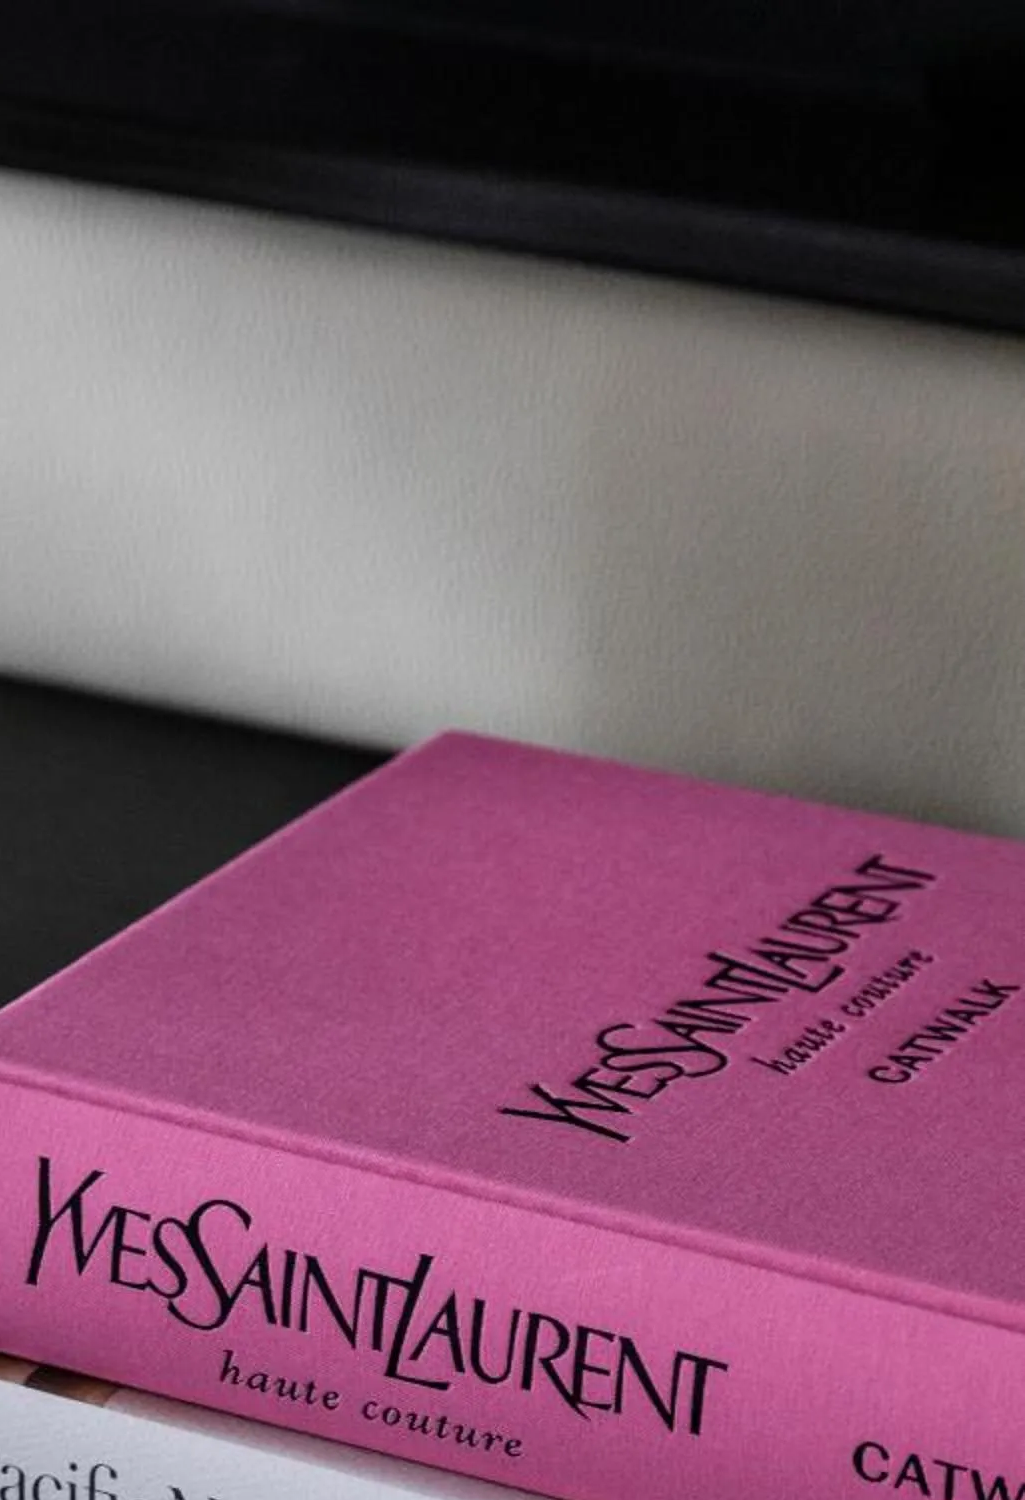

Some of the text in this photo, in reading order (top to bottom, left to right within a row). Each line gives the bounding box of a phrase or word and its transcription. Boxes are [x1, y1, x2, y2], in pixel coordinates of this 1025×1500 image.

[750, 950, 934, 1075] haute couture
[867, 978, 1022, 1084] CATWALK
[219, 1349, 524, 1458] haute couture
